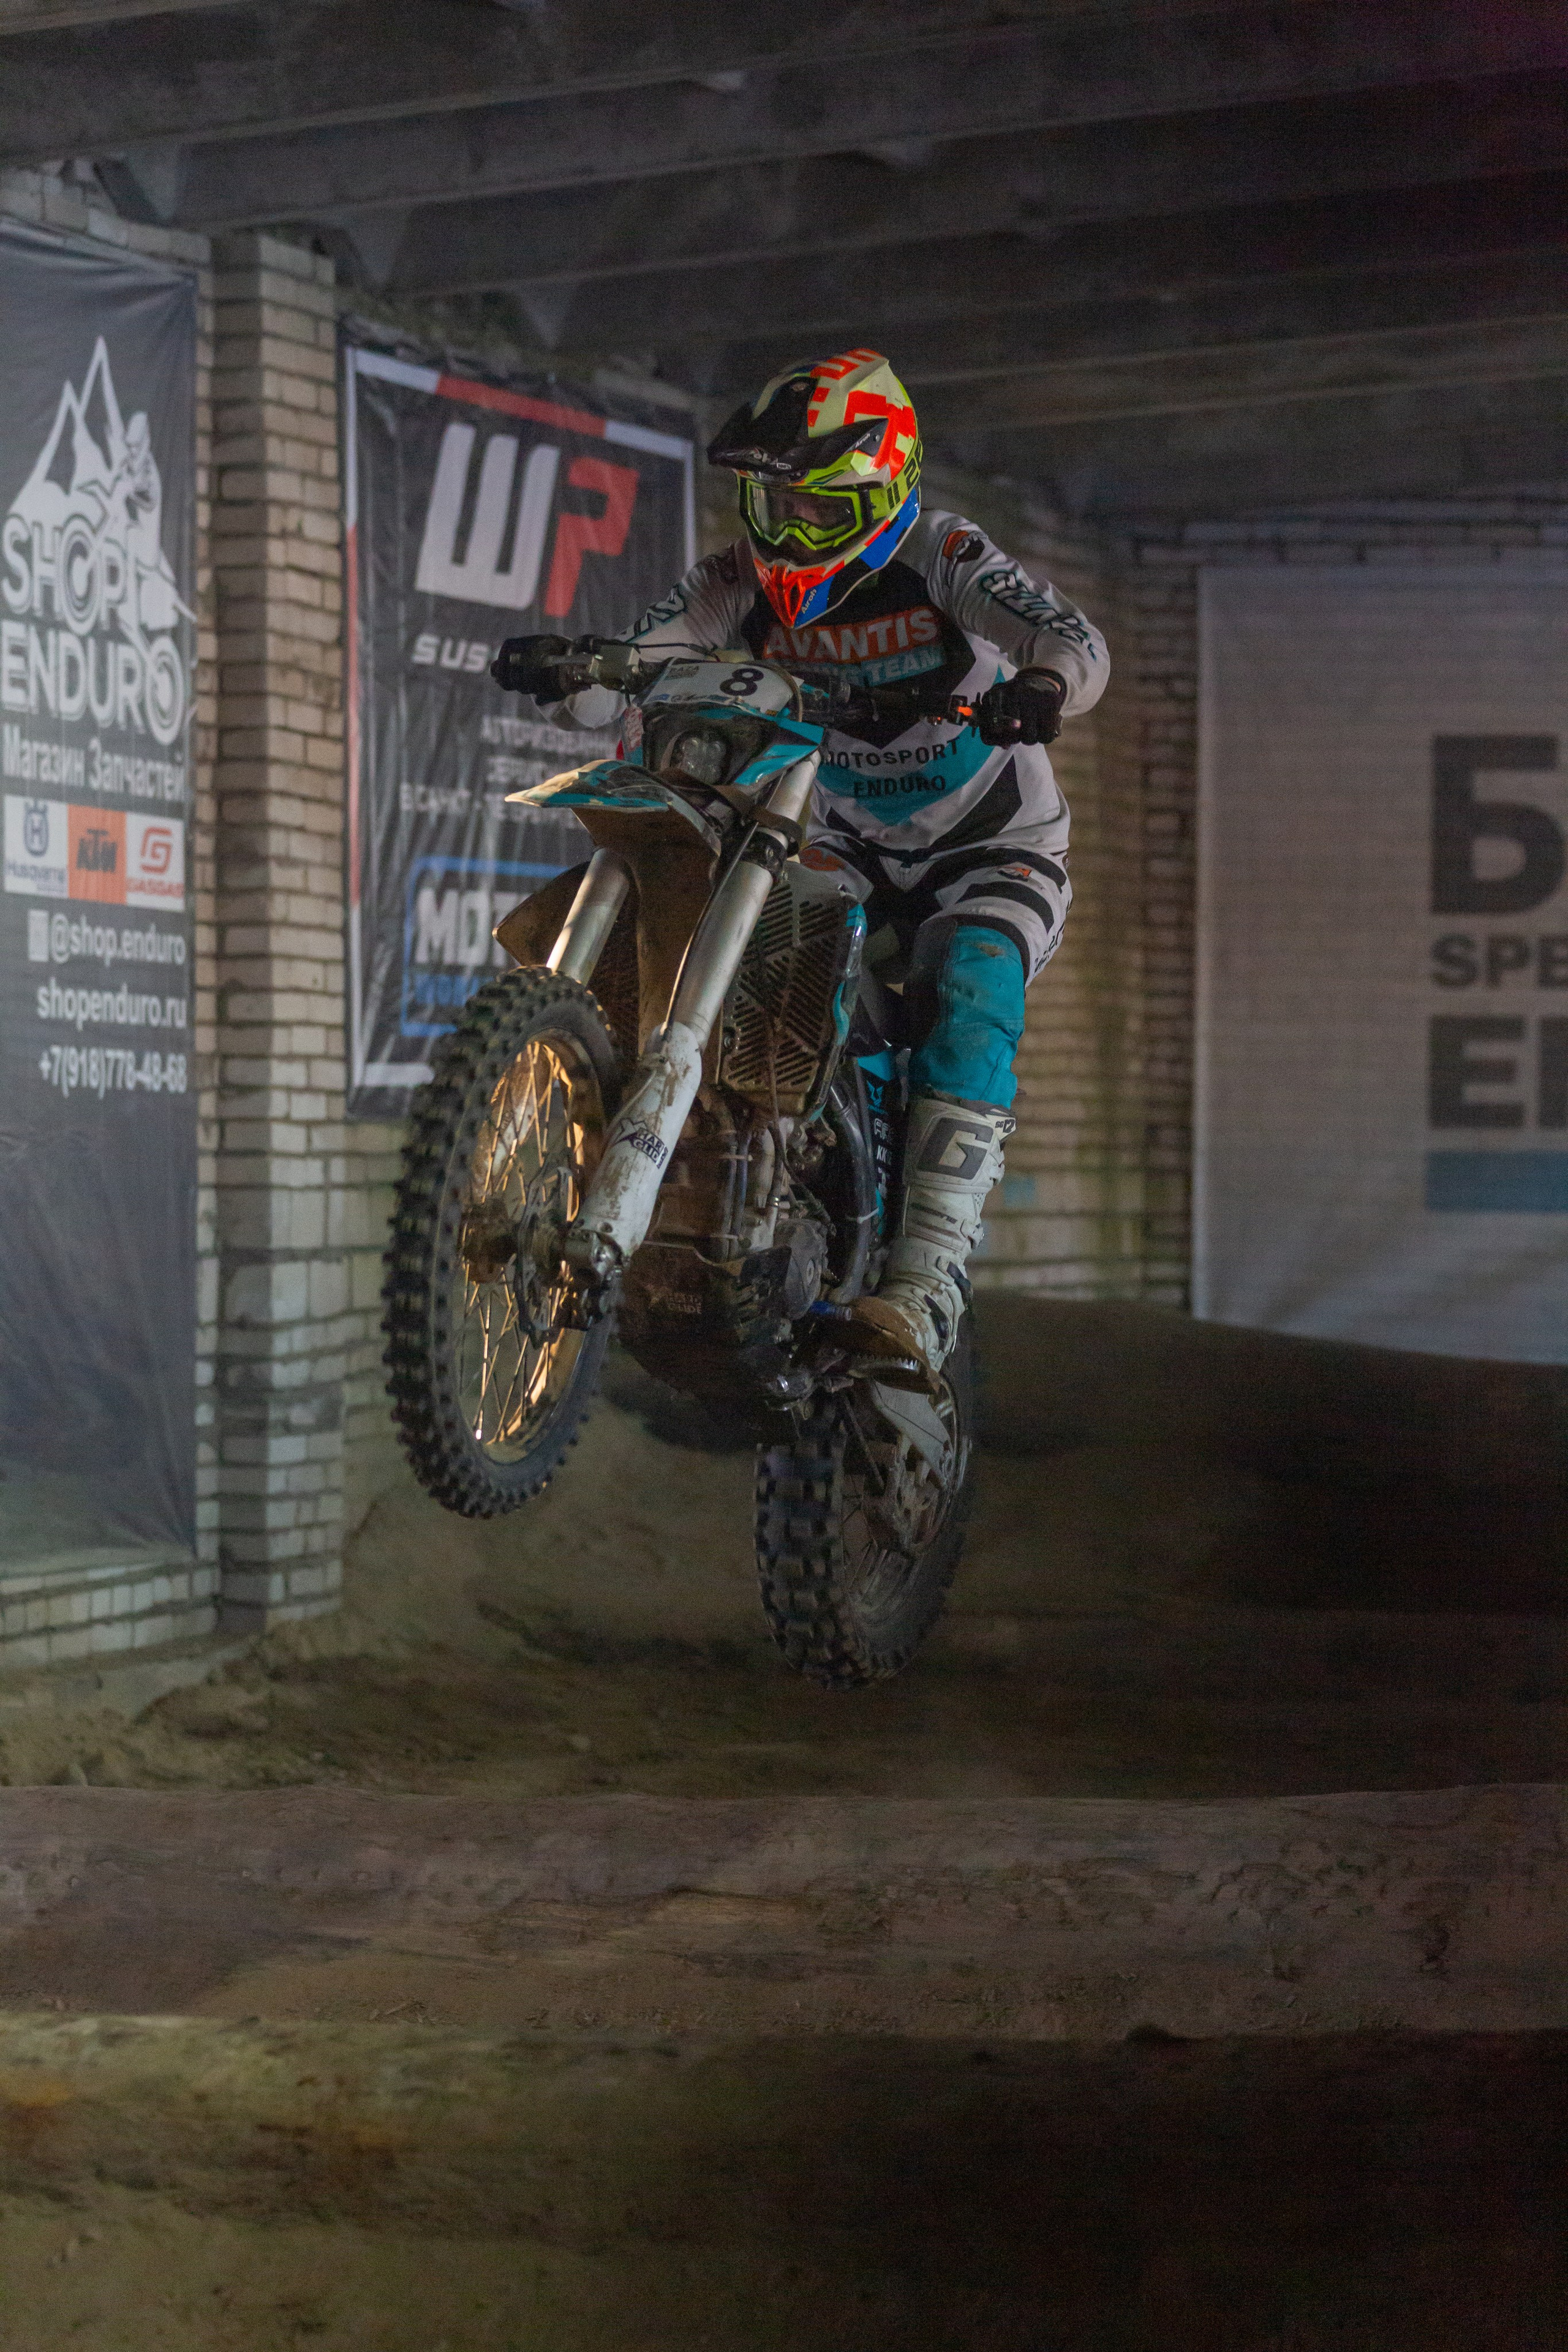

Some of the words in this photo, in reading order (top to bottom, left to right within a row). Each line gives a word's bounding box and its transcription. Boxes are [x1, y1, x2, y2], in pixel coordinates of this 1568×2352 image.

[2, 514, 126, 636] SHOP
[801, 588, 817, 614] Airoh
[766, 609, 938, 660] AVANTIS
[1, 619, 184, 745] ENDURO
[720, 668, 764, 696] 8
[865, 647, 941, 682] TEAM
[2, 723, 85, 787] Магазин
[89, 736, 184, 801] Запчастей
[854, 775, 946, 797] ENDURO
[51, 912, 186, 967] @shop.enduro
[415, 888, 532, 967] MOT
[37, 976, 187, 1031] shopenduro.ru
